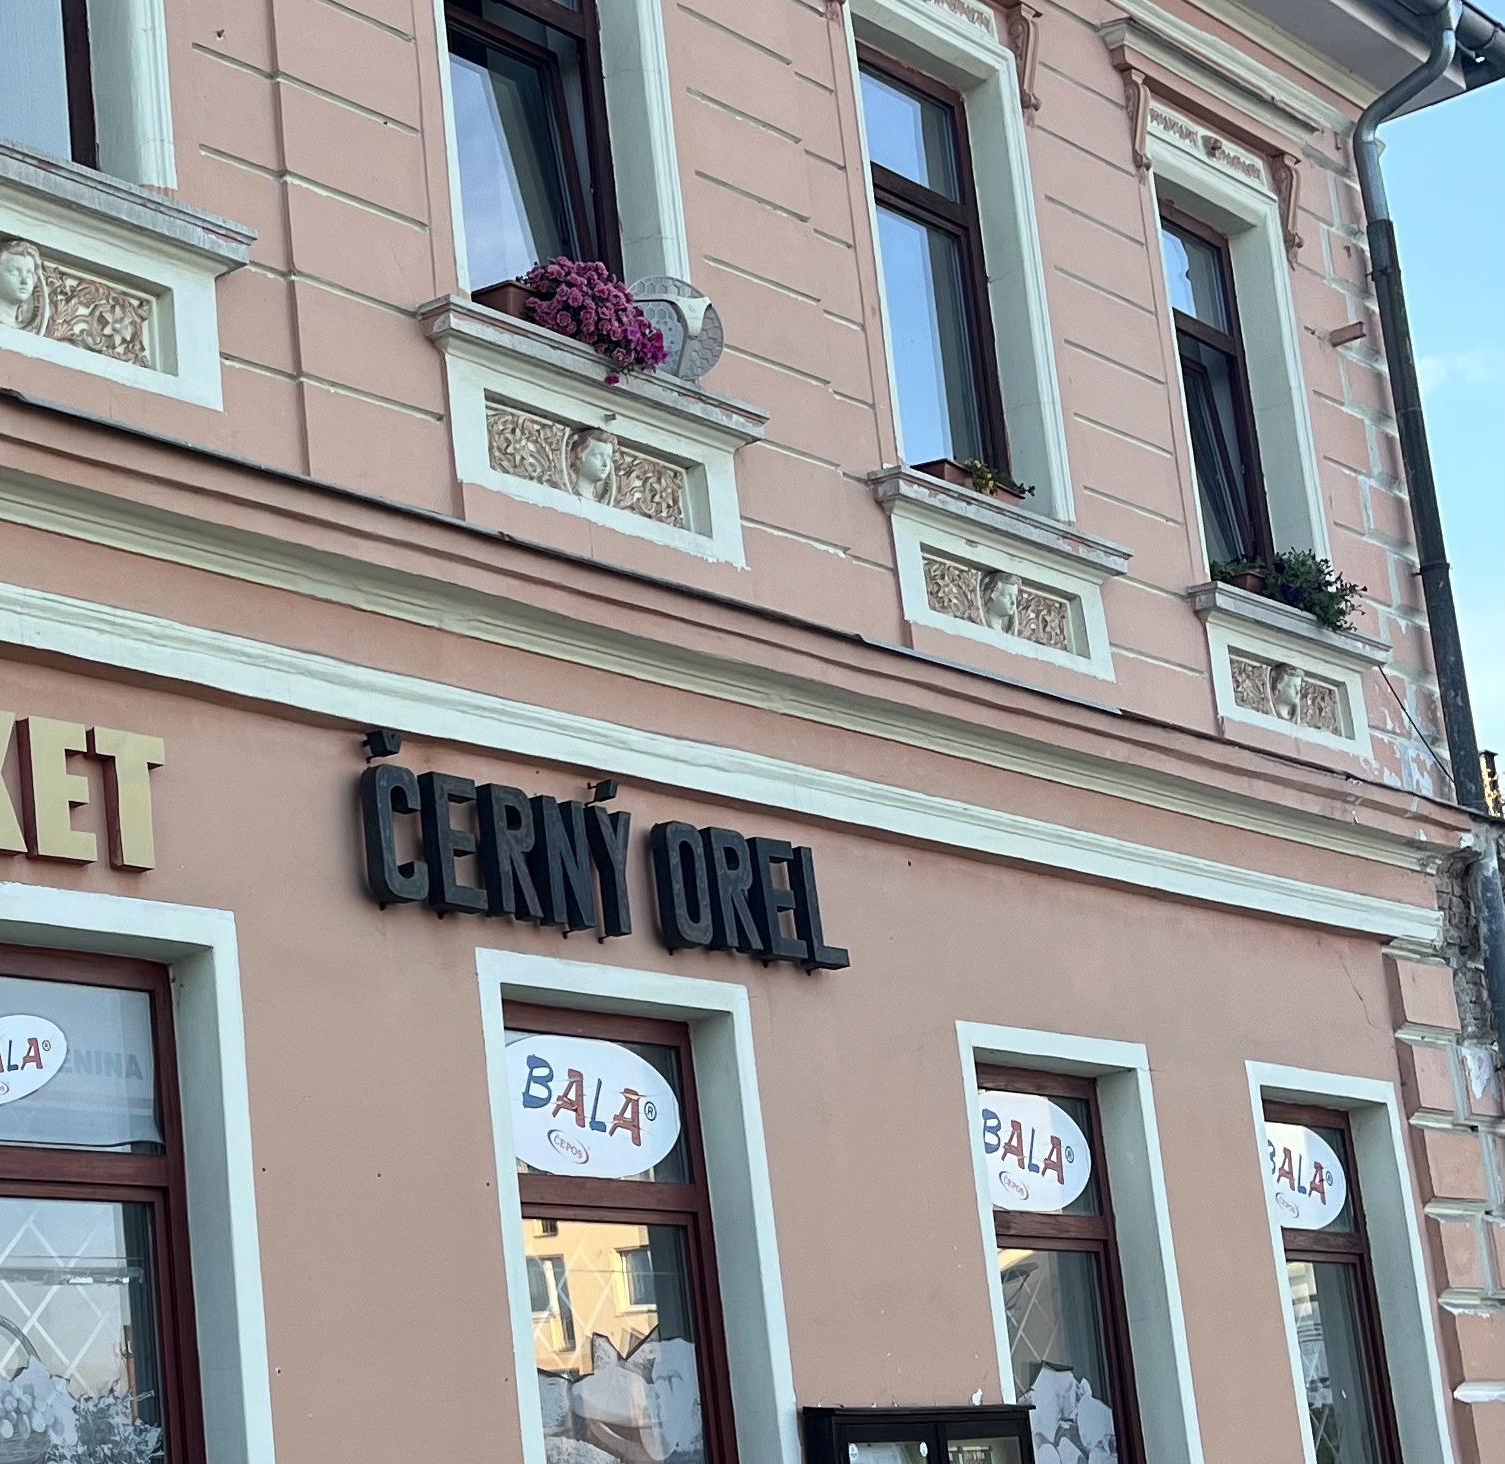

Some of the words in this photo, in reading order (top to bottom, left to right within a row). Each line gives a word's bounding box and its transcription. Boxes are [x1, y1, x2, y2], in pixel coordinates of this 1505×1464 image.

[650, 820, 851, 970] OREL
[522, 1054, 642, 1147] BALA
[981, 1108, 1065, 1186] BALA
